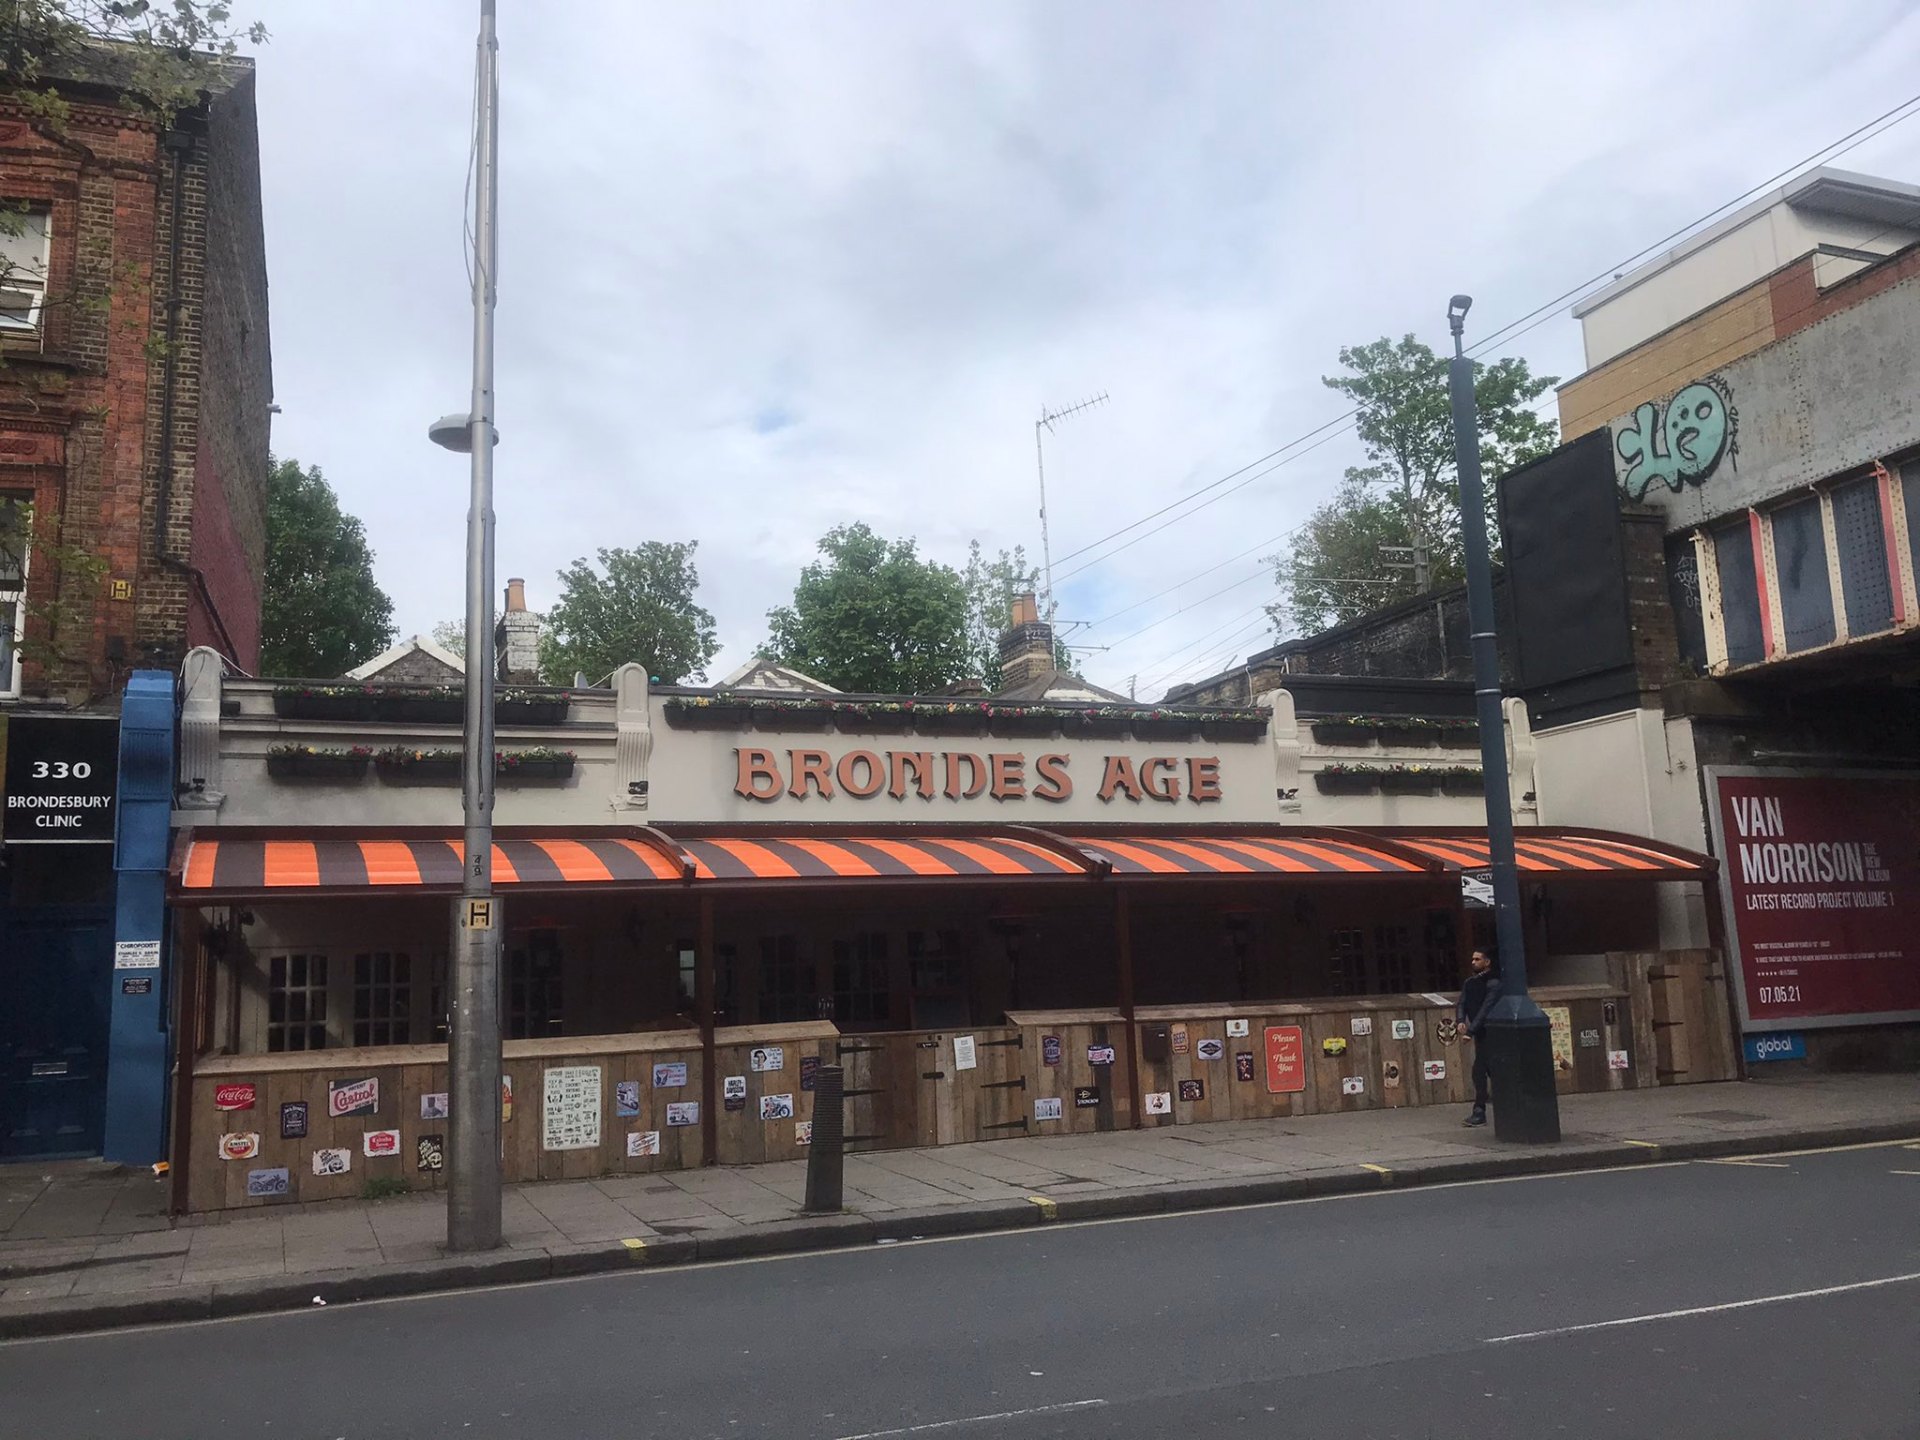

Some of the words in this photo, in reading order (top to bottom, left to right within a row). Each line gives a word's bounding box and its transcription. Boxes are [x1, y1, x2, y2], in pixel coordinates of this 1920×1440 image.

[32, 761, 92, 779] 330
[733, 748, 1074, 804] BRONDES
[1097, 756, 1224, 806] AGE
[8, 796, 111, 808] BRONDESBURY
[36, 815, 82, 827] CLINIC
[1731, 797, 1784, 837] VAN
[1862, 843, 1878, 855] THE
[1739, 842, 1865, 884] MORRISON
[1746, 894, 1779, 910] LATEST
[1781, 893, 1816, 909] RECORD
[1817, 892, 1851, 908] PROJECT
[1852, 891, 1888, 907] VOLUME
[1889, 891, 1895, 906] 1
[470, 902, 490, 926] H
[1759, 986, 1801, 1004] 07.05.21
[1272, 1034, 1297, 1043] Please
[1757, 1036, 1793, 1059] global
[1273, 1053, 1297, 1063] Thank
[1277, 1063, 1294, 1074] You
[334, 1083, 375, 1112] Castrol
